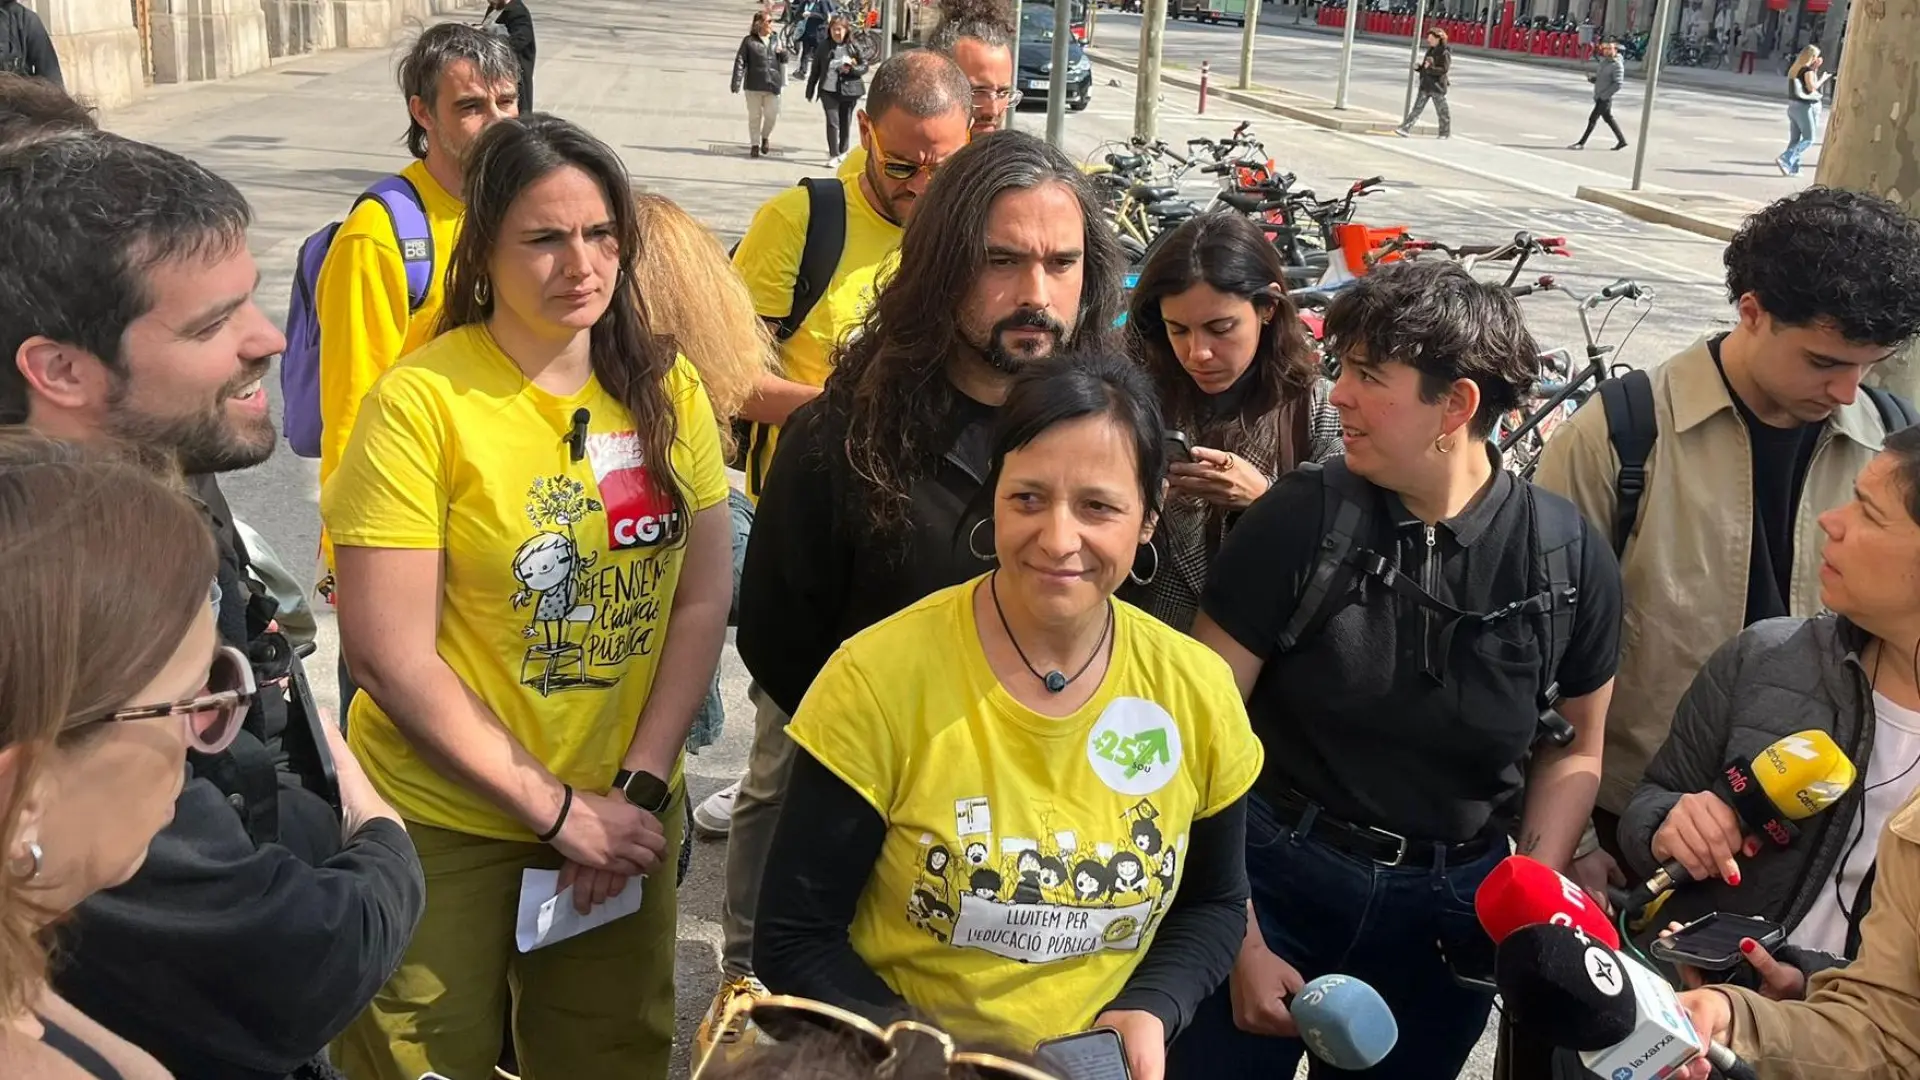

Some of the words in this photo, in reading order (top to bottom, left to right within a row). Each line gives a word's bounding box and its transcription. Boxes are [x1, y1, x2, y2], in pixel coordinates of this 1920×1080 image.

[614, 513, 678, 545] CGT
[1006, 909, 1062, 928] LLUITEM
[1065, 911, 1089, 930] PER
[967, 927, 1042, 952] L'EDUCACIÓ
[1046, 934, 1097, 955] PÚBLICA
[1643, 1034, 1676, 1060] xarxa
